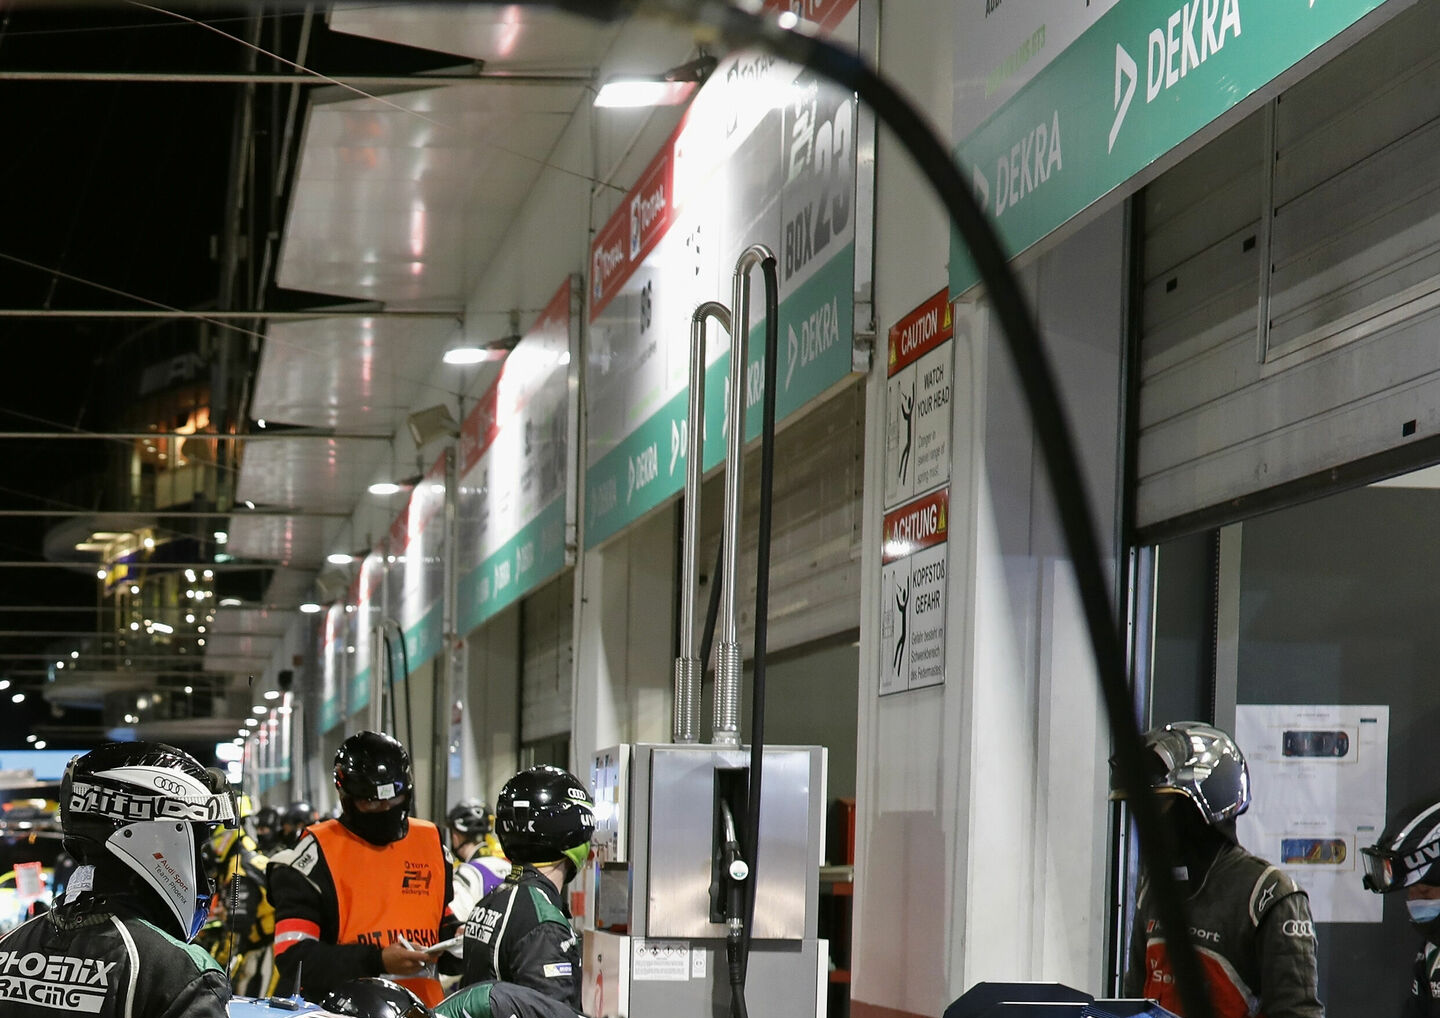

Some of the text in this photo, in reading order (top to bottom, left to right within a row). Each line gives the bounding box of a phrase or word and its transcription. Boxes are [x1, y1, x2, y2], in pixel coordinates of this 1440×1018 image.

[1146, 0, 1242, 104] DEKRA
[996, 109, 1062, 217] DEKRA
[785, 203, 813, 282] BOX
[800, 296, 839, 368] DEKRA
[901, 308, 938, 356] CAUTION
[923, 363, 944, 390] WATCH
[917, 386, 950, 419] YOUR HEAD
[893, 503, 937, 543] ACHTUNG
[915, 590, 941, 615] GEFAHR
[154, 864, 188, 905] Team Phoenix
[160, 859, 189, 892] Audi Sport
[1190, 925, 1222, 943] port
